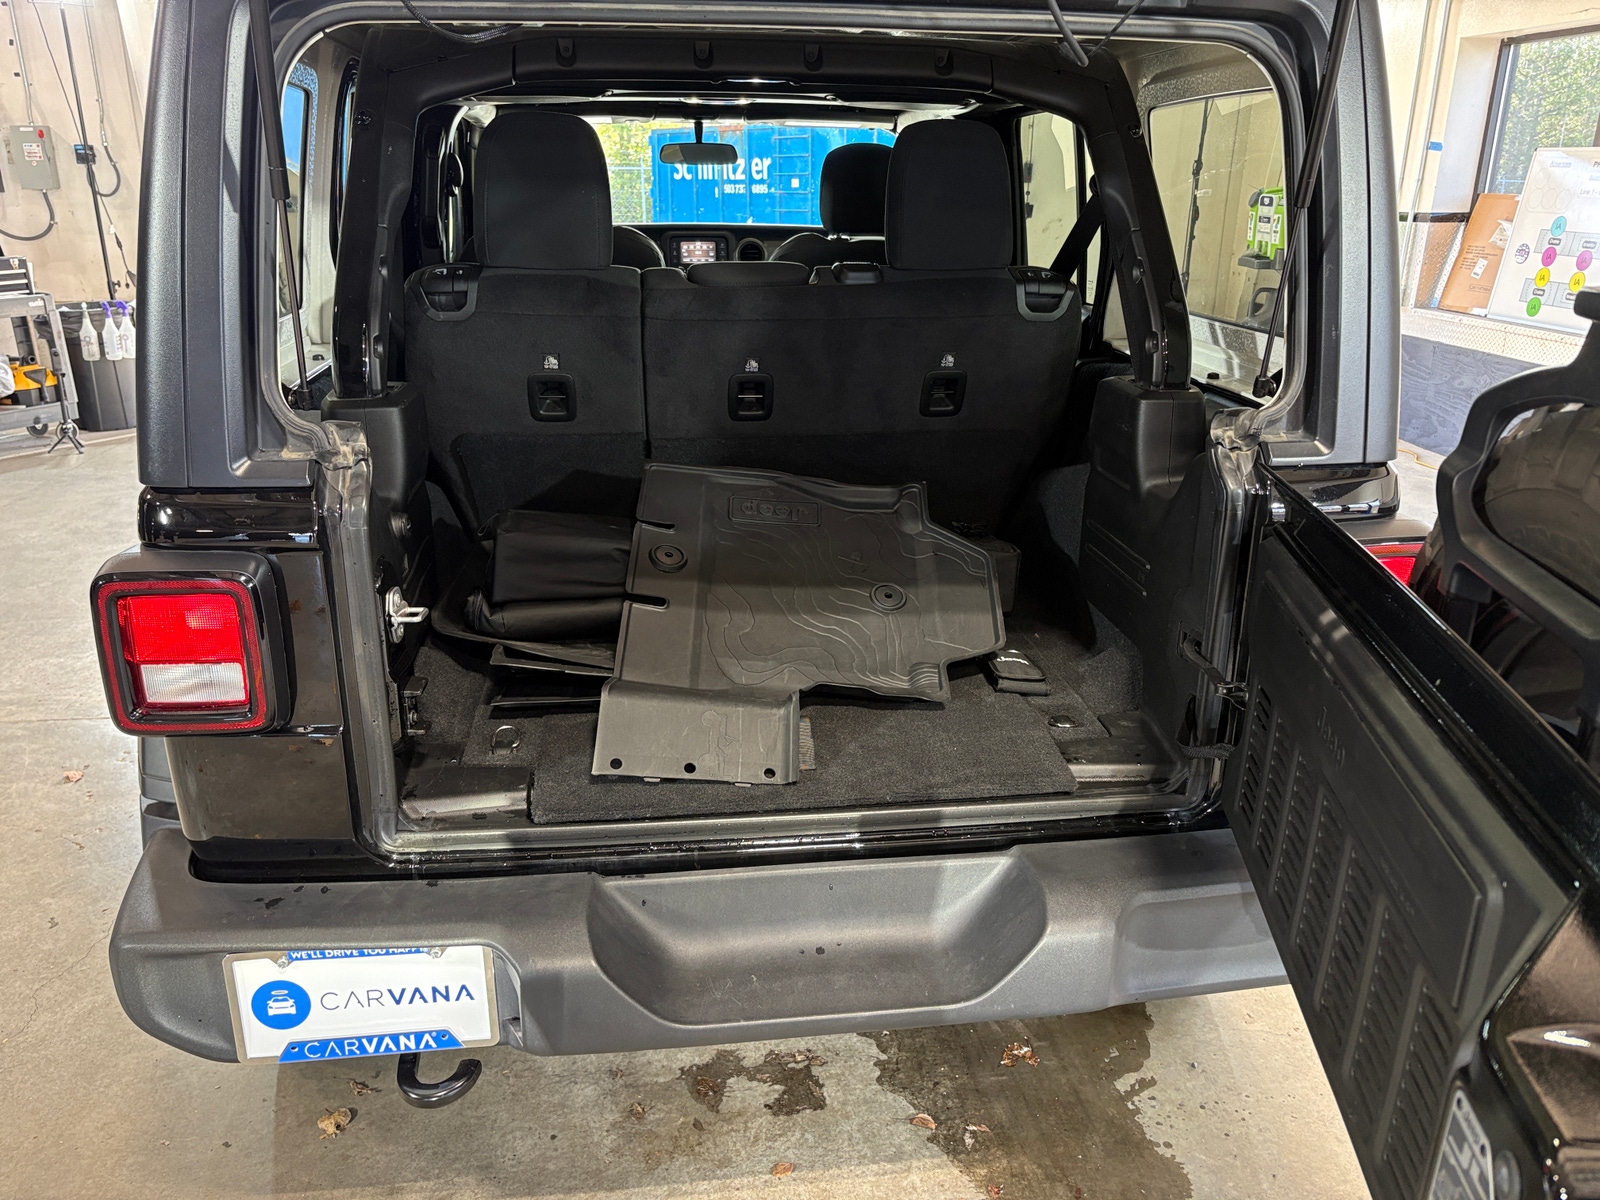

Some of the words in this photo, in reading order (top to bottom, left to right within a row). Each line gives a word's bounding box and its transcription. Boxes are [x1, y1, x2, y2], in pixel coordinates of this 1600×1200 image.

[290, 951, 323, 960] WE'LL
[325, 949, 360, 958] DRIVE
[320, 984, 475, 1011] CARVANA
[304, 1032, 438, 1058] CARVANA
